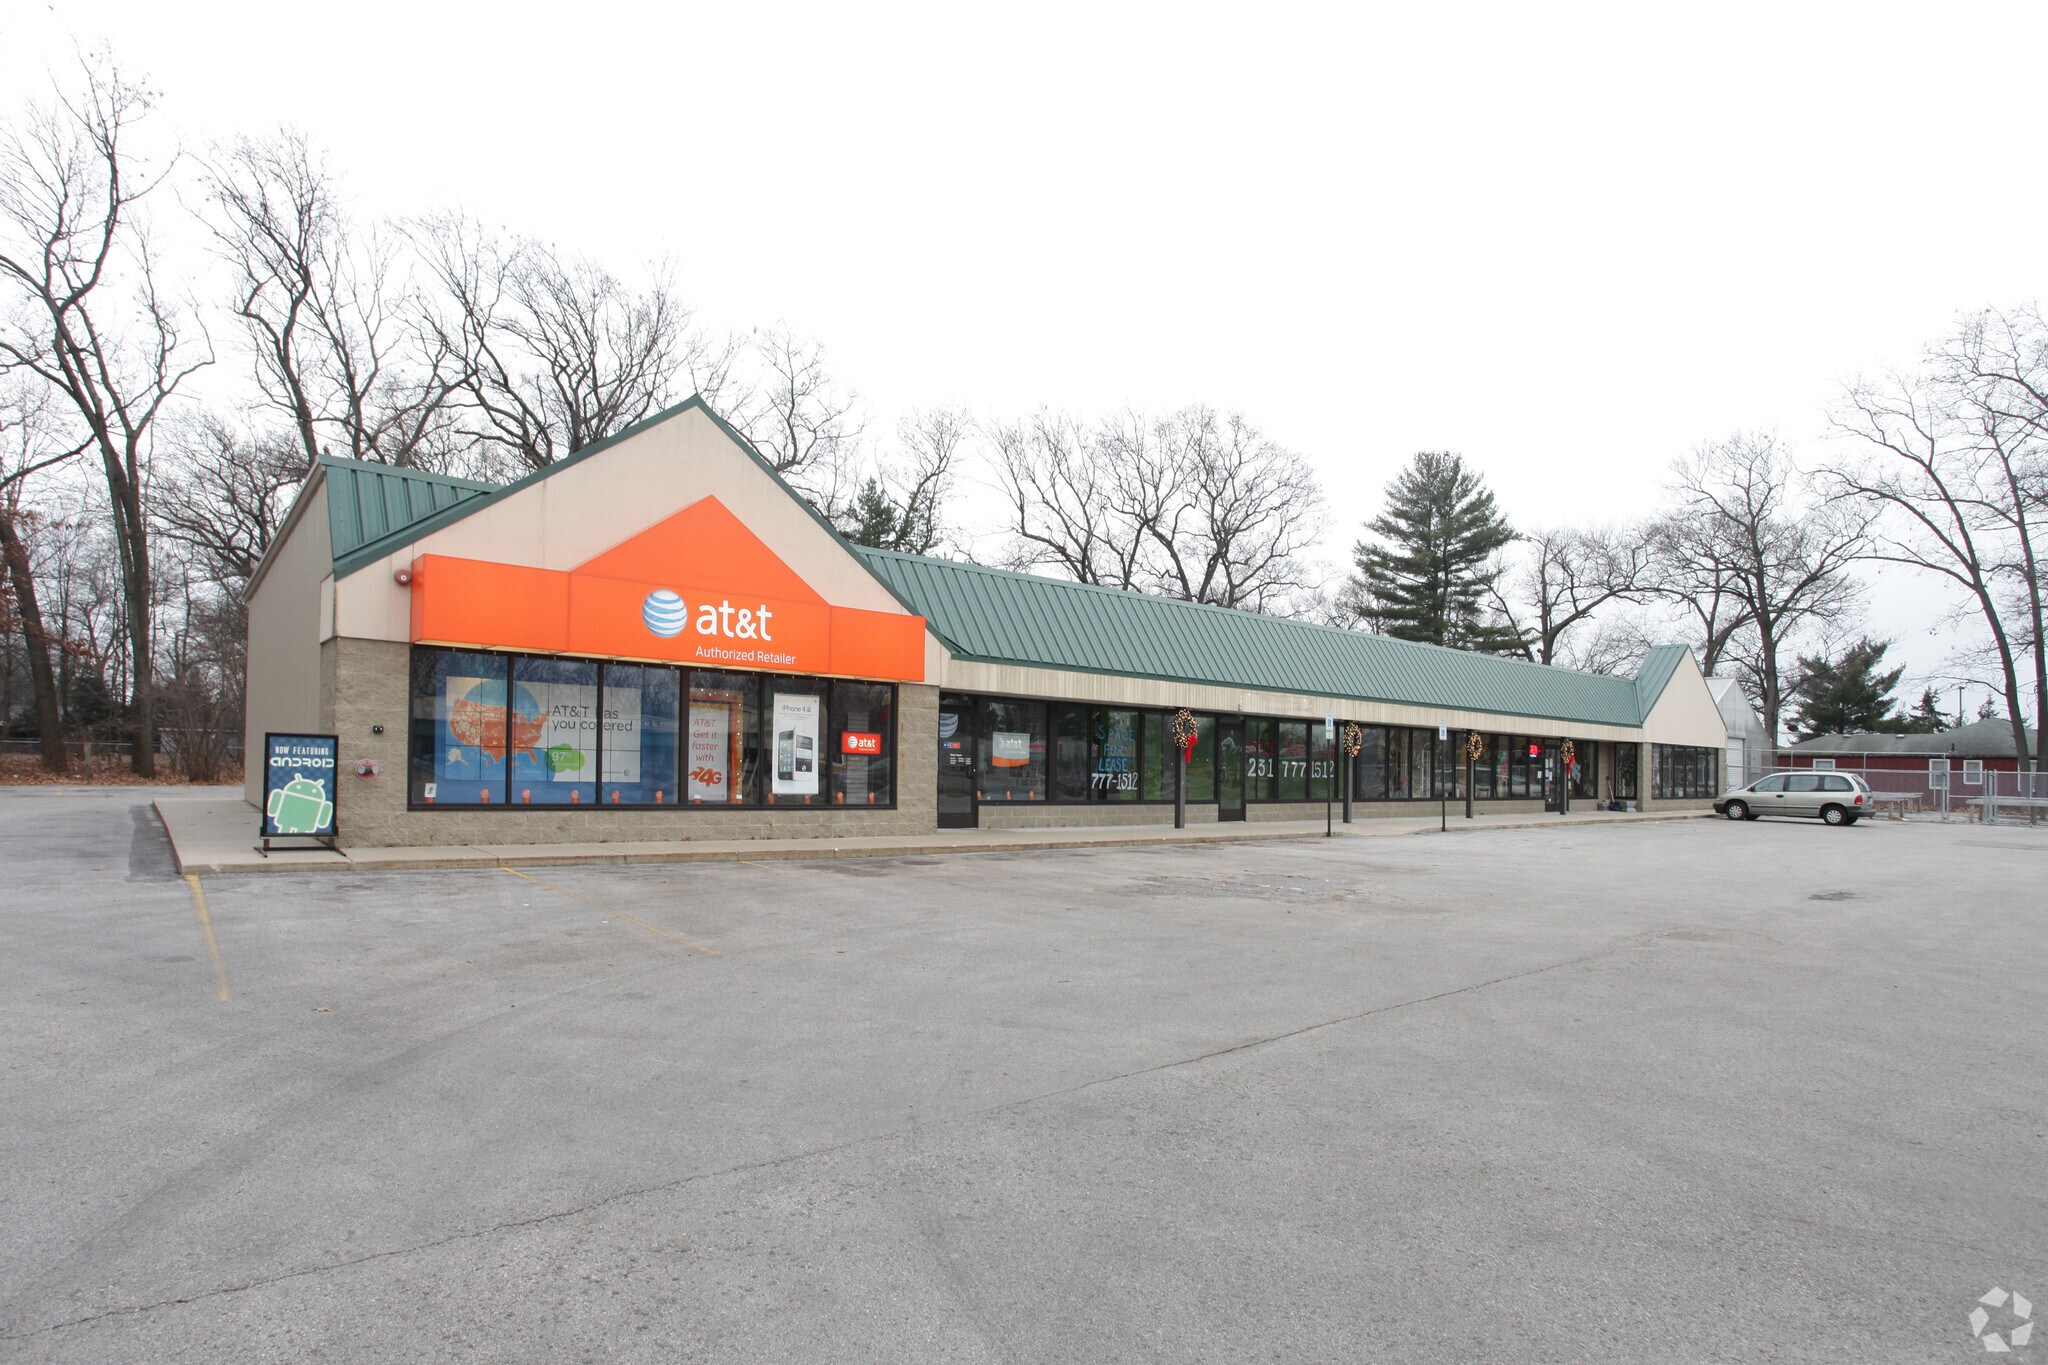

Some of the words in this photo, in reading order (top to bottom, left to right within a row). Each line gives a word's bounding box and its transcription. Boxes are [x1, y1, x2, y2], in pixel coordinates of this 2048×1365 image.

[696, 600, 773, 642] at&t
[696, 646, 755, 662] Authorized
[756, 651, 796, 665] Retailer
[551, 705, 590, 718] AT&T
[597, 706, 619, 720] as
[552, 719, 576, 732] you
[580, 720, 633, 732] coered
[1098, 724, 1136, 743] SPACE
[693, 729, 709, 739] Get
[711, 730, 718, 739] it
[275, 746, 289, 754] NOW
[293, 746, 329, 755] FEATURING
[692, 740, 718, 751] faster
[858, 737, 876, 748] at&t
[1103, 742, 1126, 758] FOR
[695, 753, 714, 762] with
[1098, 757, 1129, 773] LEASE
[1247, 757, 1274, 778] 231
[1282, 760, 1307, 778] 777
[698, 768, 723, 788] 4G
[1091, 772, 1140, 791] 777-1512
